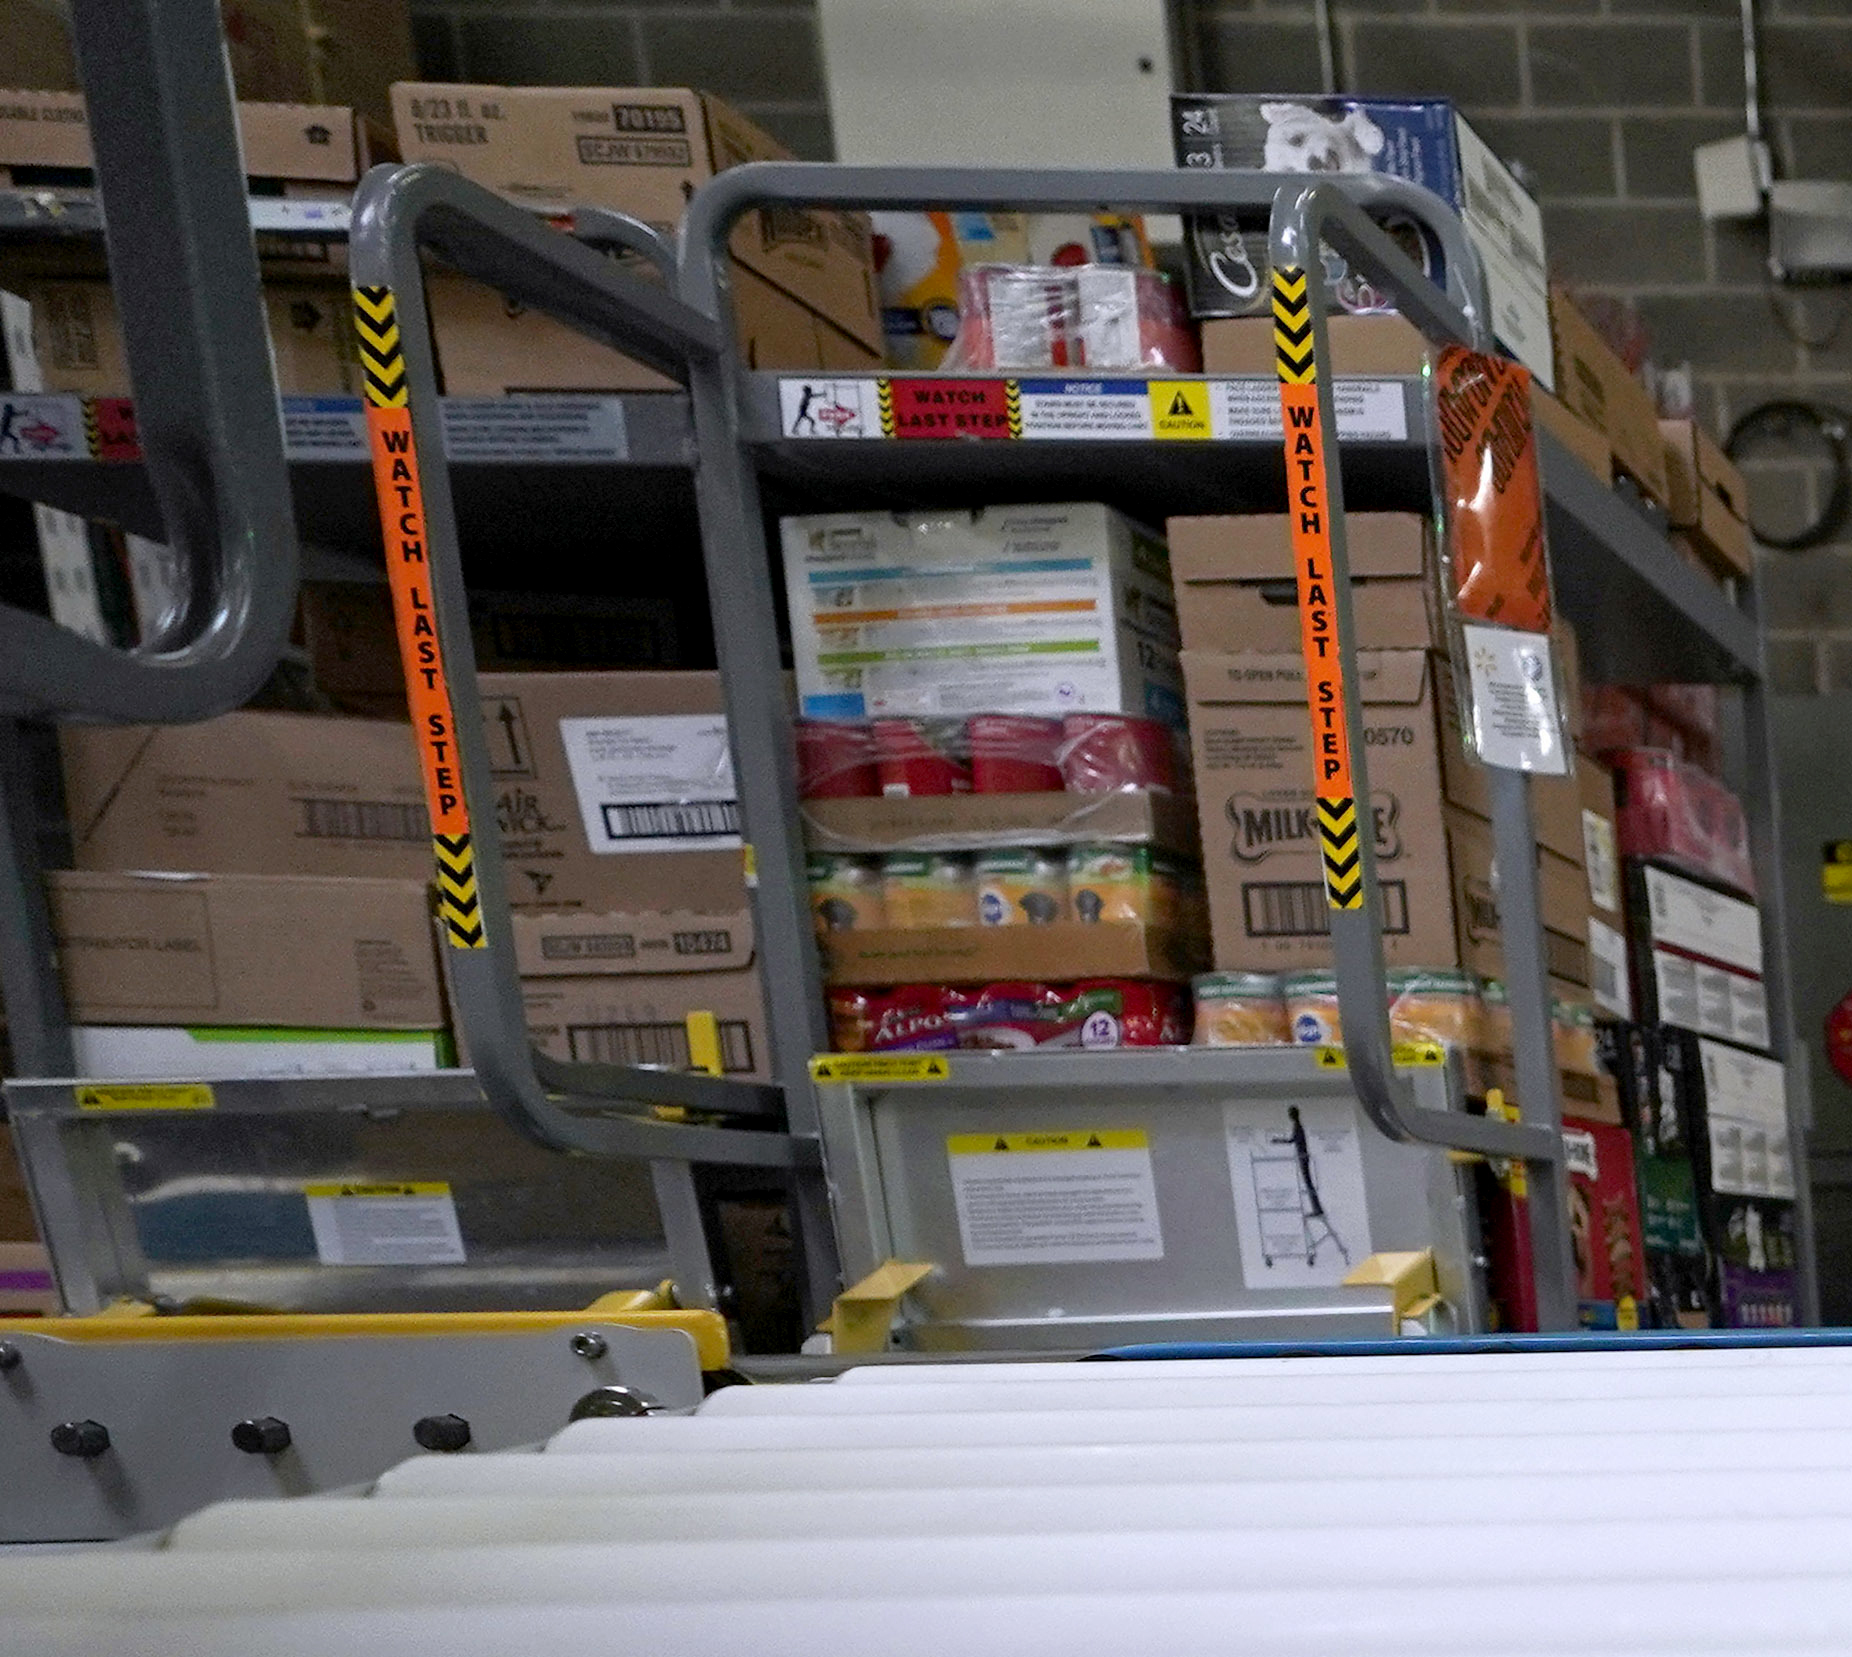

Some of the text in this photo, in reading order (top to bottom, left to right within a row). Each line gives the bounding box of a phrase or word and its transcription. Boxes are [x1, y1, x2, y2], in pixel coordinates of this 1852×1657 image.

[914, 390, 986, 404] WATCH
[900, 413, 951, 428] LAST
[956, 413, 1008, 428] STEP
[1159, 420, 1205, 430] CAUTION
[1288, 406, 1340, 780] WATCH LAST STEP
[382, 430, 458, 815] WATCH LAST STEP
[1089, 1020, 1110, 1038] 12
